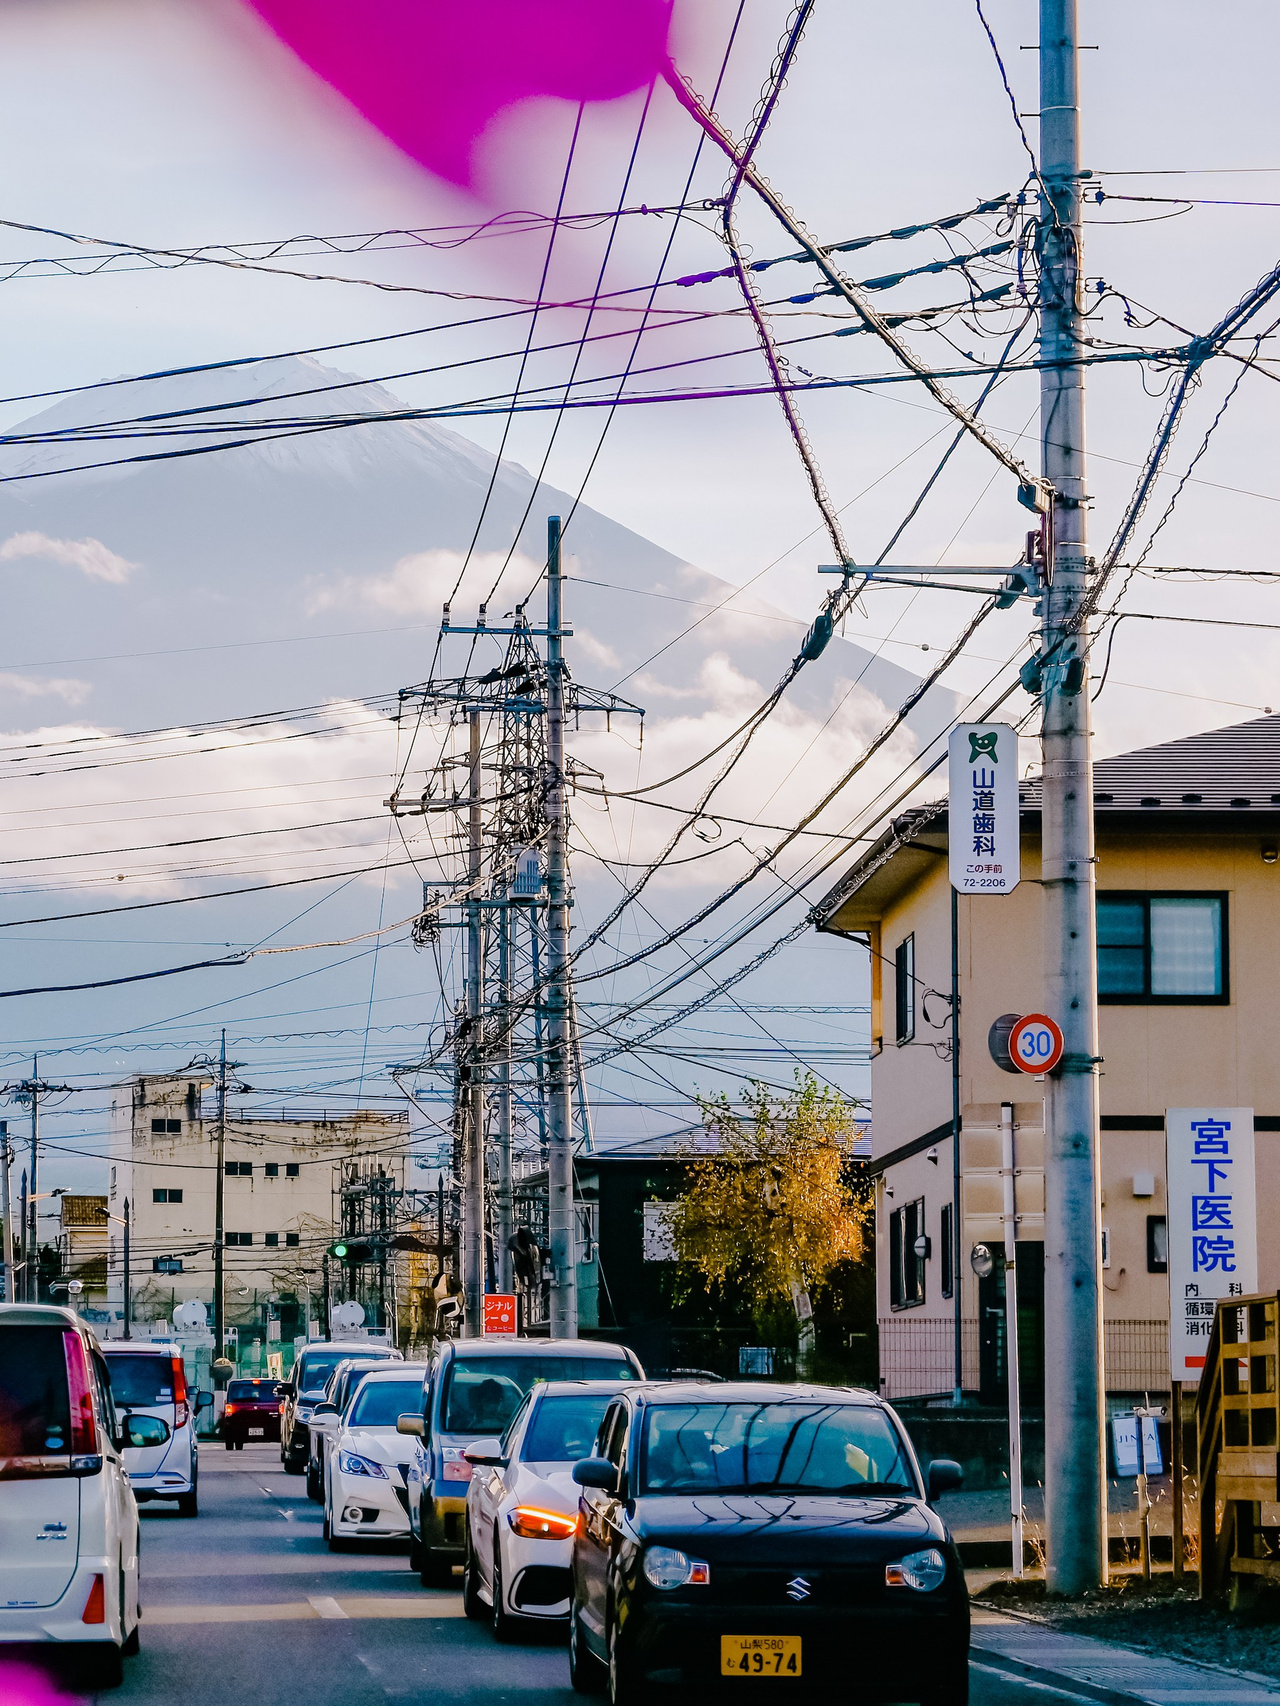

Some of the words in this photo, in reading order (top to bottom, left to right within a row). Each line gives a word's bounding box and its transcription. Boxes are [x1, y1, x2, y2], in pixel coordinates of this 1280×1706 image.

[972, 768, 996, 857] 山道歯科
[966, 864, 1002, 874] この手前
[963, 878, 1006, 887] 72-2206
[1022, 1031, 1050, 1057] 30
[1191, 1118, 1237, 1272] 宮下医院
[739, 1652, 798, 1674] 49-74
